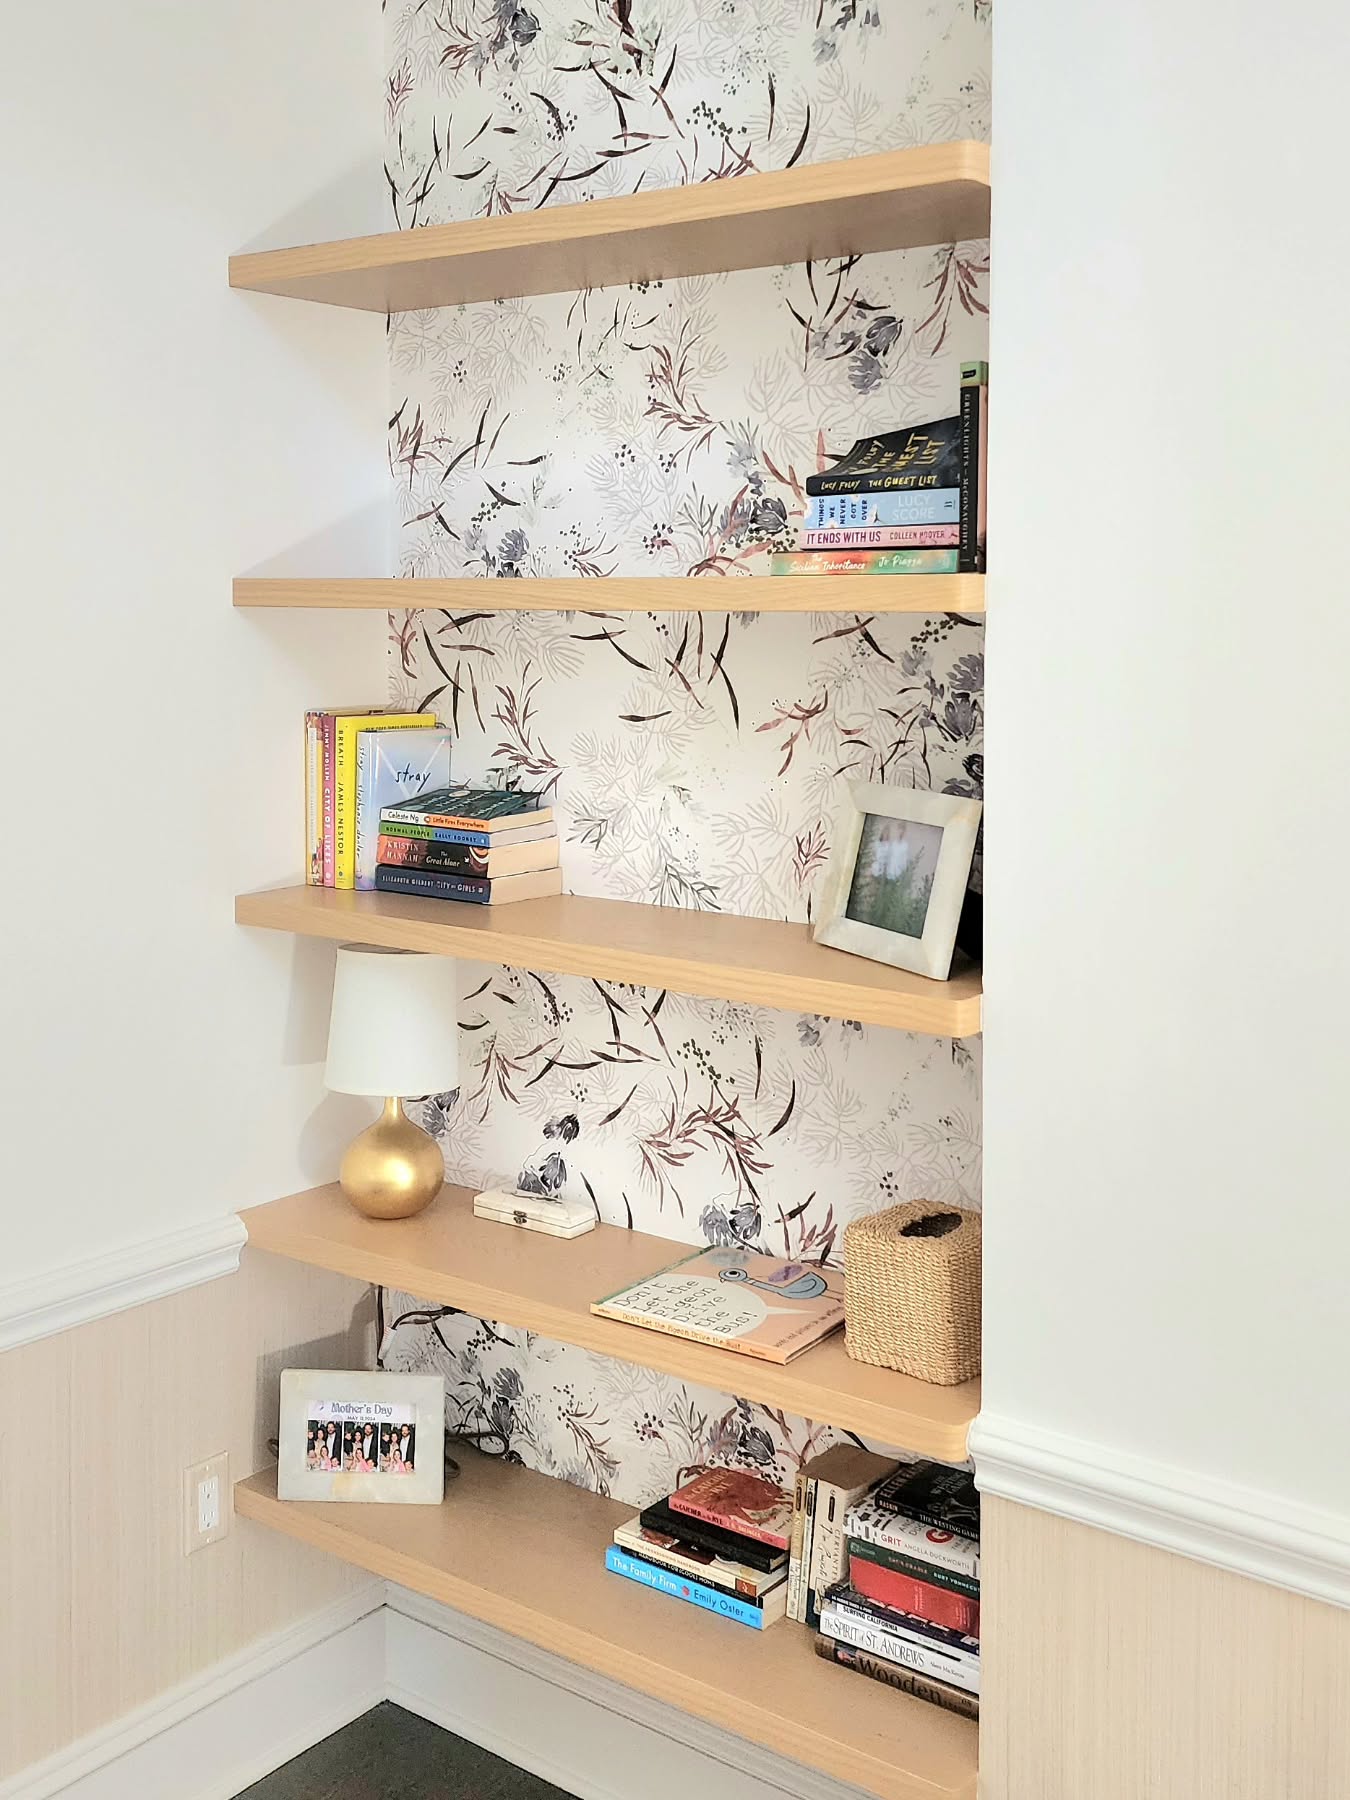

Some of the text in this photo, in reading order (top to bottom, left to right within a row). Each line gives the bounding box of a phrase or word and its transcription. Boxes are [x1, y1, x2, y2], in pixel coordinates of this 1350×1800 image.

[962, 394, 971, 551] GREENLIGHTS McCONAUGHEY
[820, 475, 938, 490] LUCY FOLEY THE GUEST LIST
[897, 494, 931, 508] LUCY
[829, 506, 836, 519] WE
[892, 507, 936, 521] SCORE
[806, 531, 881, 545] IT ENDS WITH US
[889, 530, 945, 540] COLLEEN HOOVER
[823, 560, 866, 571] Inheritance
[395, 762, 431, 792] stray
[324, 815, 331, 829] OF
[388, 811, 409, 821] Celeste
[410, 815, 419, 823] Ng
[457, 819, 485, 829] Everywhere
[386, 826, 408, 834] NORMAL
[387, 840, 419, 851] KRISTIN
[386, 851, 419, 863] HANNAH
[426, 856, 460, 868] Great Alone
[382, 875, 410, 884] ELIZABETH
[411, 878, 434, 887] GILBERT
[436, 881, 450, 889] CITY
[457, 884, 476, 893] GIRLS
[614, 1282, 668, 1307] Don't
[632, 1279, 699, 1312] Let the
[652, 1286, 717, 1317] Pigeon
[672, 1295, 727, 1323] Drive
[694, 1310, 730, 1327] the
[713, 1311, 758, 1334] Bus!
[622, 1313, 641, 1324] Don't
[640, 1317, 653, 1327] Let
[654, 1320, 666, 1330] the
[667, 1324, 690, 1337] Pigeon
[691, 1330, 711, 1342] Drive
[712, 1335, 724, 1344] the
[331, 1402, 393, 1417] Mother's Day
[920, 1514, 933, 1523] THE
[933, 1516, 961, 1534] WESTING
[880, 1533, 970, 1570] GRIT ANGELA DUCKWORTH
[933, 1572, 948, 1581] KURT
[612, 1557, 628, 1571] The
[629, 1561, 657, 1585] Family
[659, 1574, 677, 1591] Firm
[694, 1589, 717, 1608] Emily
[720, 1599, 744, 1617] Oster
[842, 1606, 898, 1632] SURFING CALIFORNIA
[824, 1617, 834, 1630] The
[833, 1617, 858, 1642] SPIRIT
[865, 1630, 879, 1650] ST.
[880, 1636, 925, 1668] ANDREWS
[856, 1655, 943, 1706] Wooden
